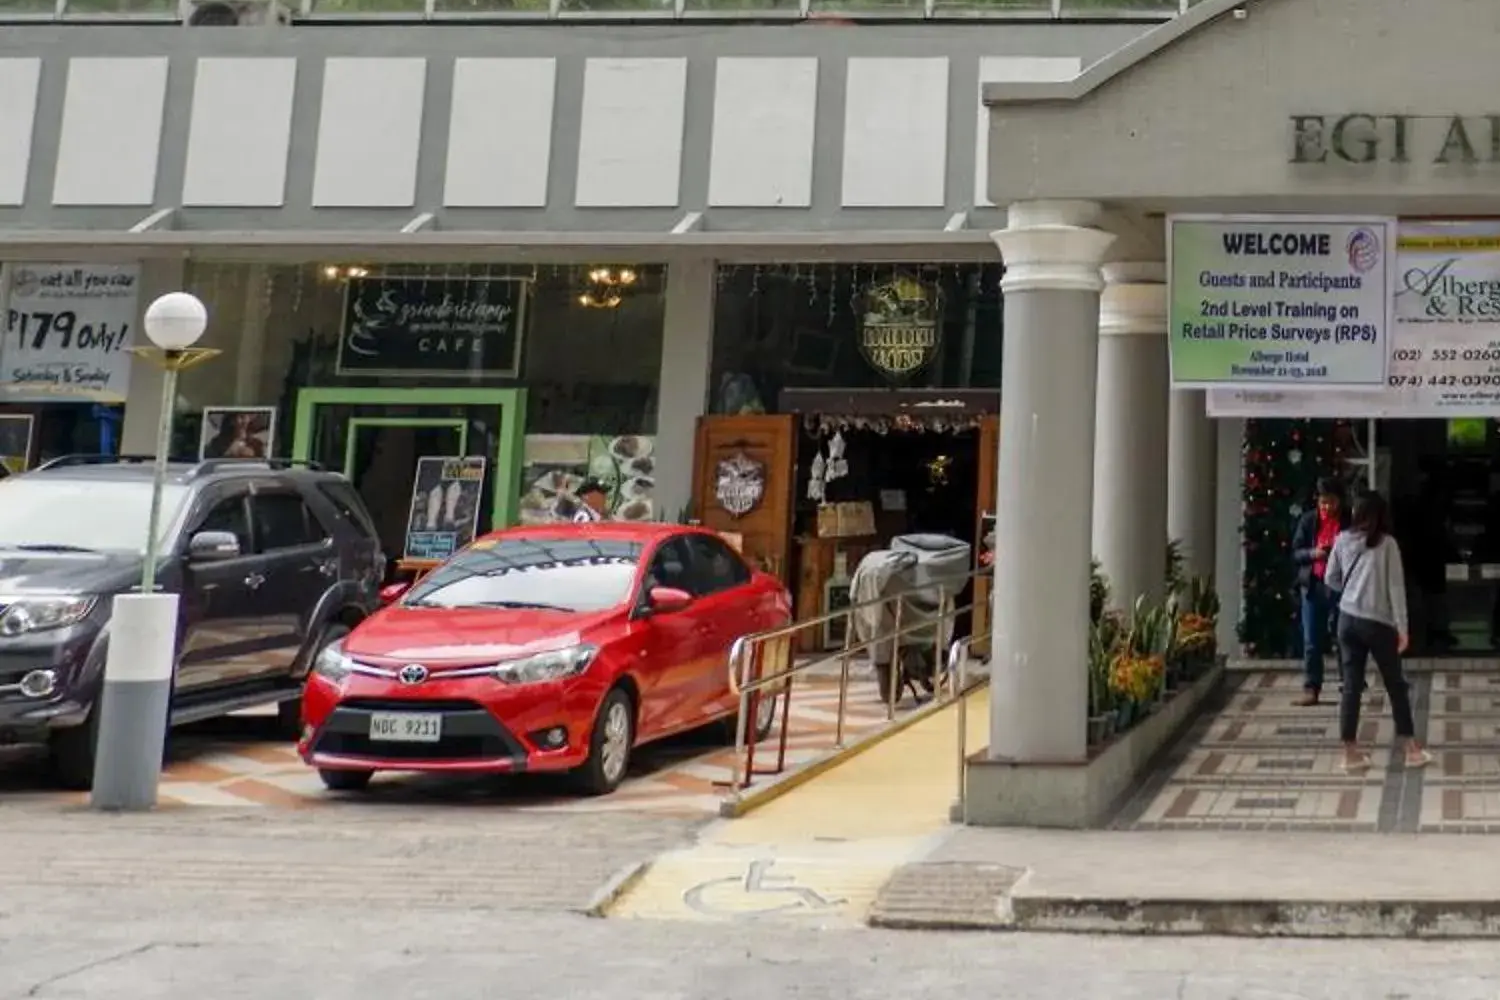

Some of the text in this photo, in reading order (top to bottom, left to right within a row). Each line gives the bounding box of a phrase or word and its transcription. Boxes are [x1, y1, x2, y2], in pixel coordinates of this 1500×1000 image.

[1287, 112, 1411, 163] EGI
[1223, 233, 1331, 255] WELCOME
[1199, 270, 1362, 292] Guests and Participants
[1200, 300, 1359, 321] 2nd Level Training on
[1425, 296, 1448, 316] &
[1182, 324, 1378, 344] Retail Price Surveys (RPS)
[418, 337, 482, 352] CAFE
[1392, 350, 1422, 361] (02)
[1388, 376, 1422, 387] 074)
